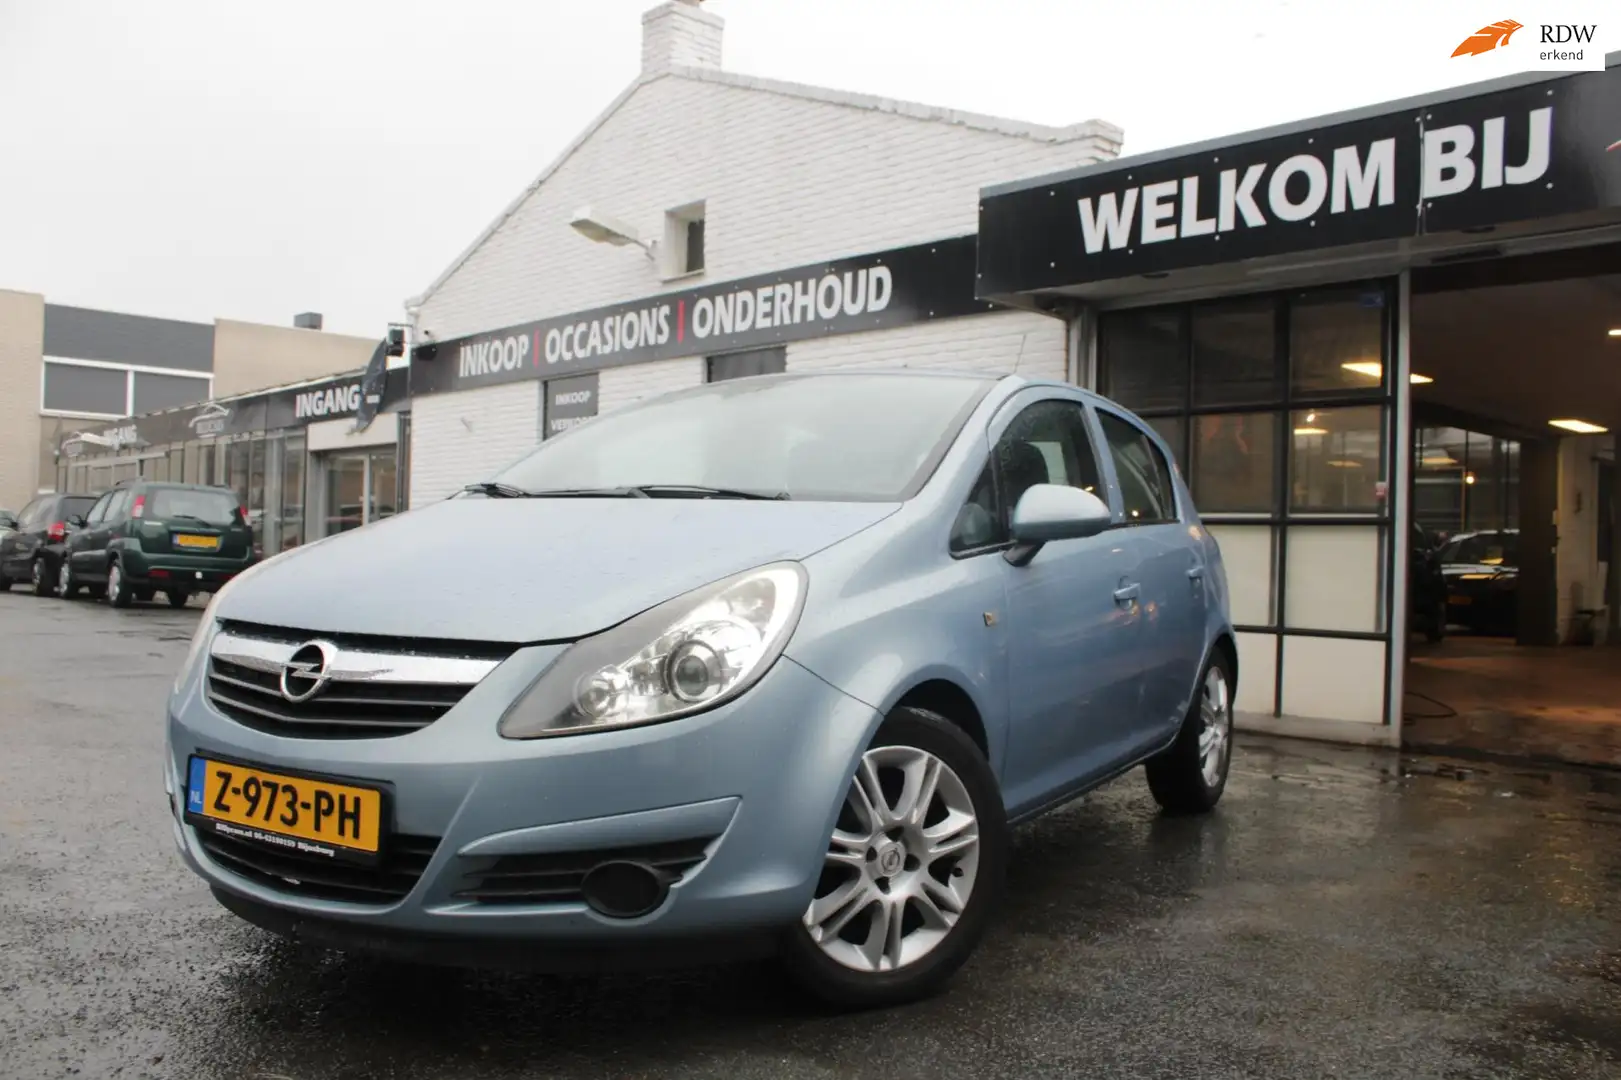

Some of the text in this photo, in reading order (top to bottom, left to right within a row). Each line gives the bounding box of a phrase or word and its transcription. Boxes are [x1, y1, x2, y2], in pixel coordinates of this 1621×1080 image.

[1078, 106, 1554, 254] WELKOM BIJ
[459, 265, 893, 377] INKOOP OCCASIONS ONDERHOUD
[295, 384, 361, 418] INGANG
[555, 390, 592, 406] INKOOP
[189, 790, 203, 804] NL
[214, 770, 361, 840] Z-973-PH
